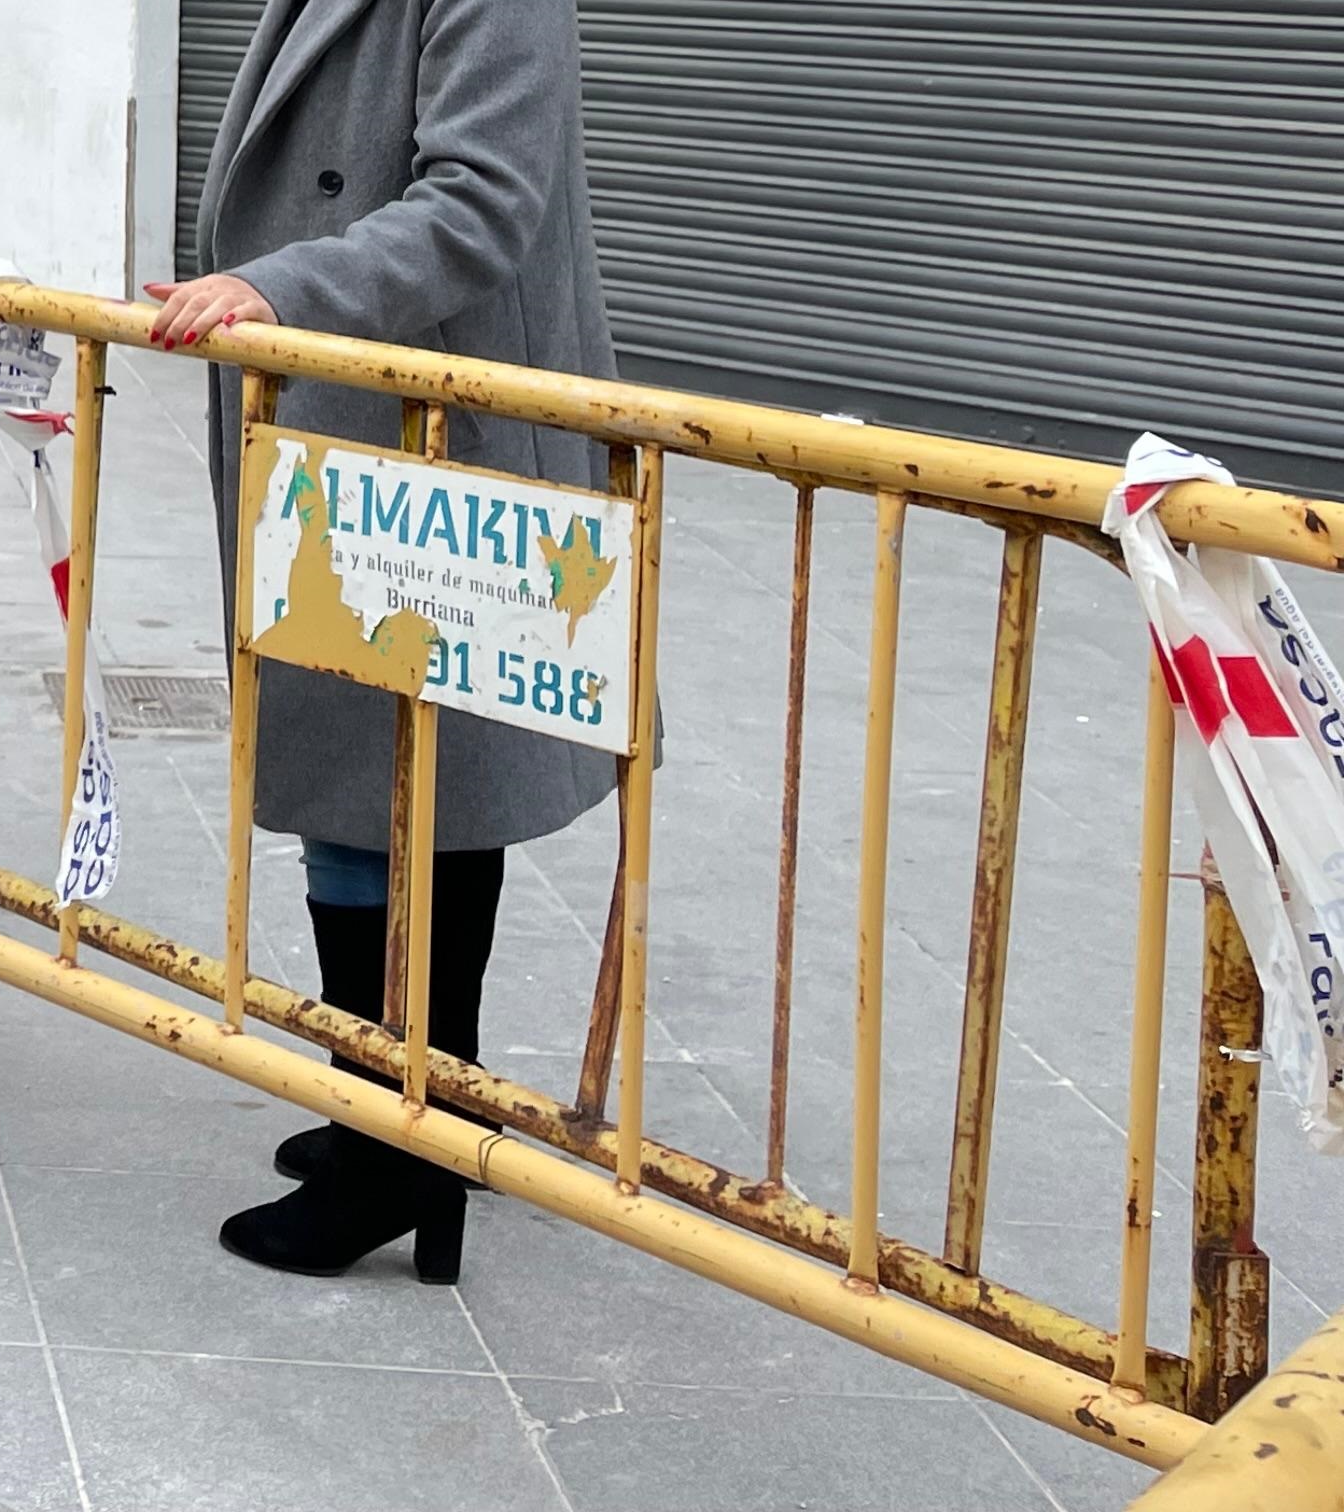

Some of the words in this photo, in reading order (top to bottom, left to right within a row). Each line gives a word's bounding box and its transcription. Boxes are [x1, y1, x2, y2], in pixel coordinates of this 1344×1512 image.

[350, 551, 361, 571] y
[365, 551, 434, 585] alquiler
[441, 567, 462, 590] de
[468, 575, 558, 611] maquinar
[386, 587, 475, 628] Burriana
[497, 649, 603, 727] 588
